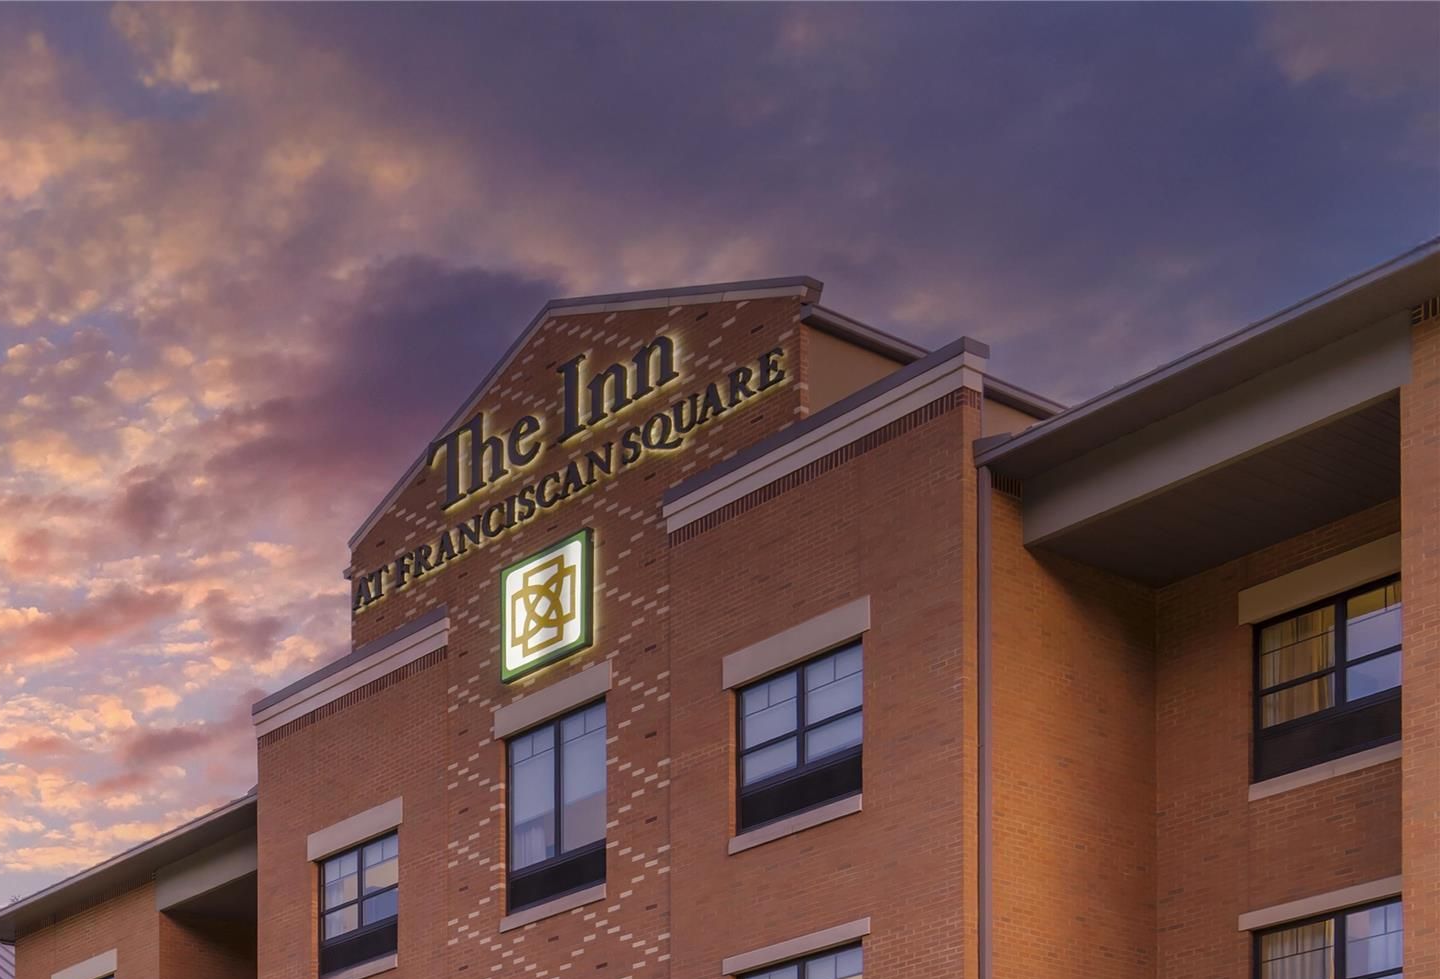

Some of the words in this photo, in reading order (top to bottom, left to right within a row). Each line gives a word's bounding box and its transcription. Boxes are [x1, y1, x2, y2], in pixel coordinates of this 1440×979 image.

[353, 564, 389, 611] AT
[395, 441, 614, 588] FRANCISCAN
[621, 347, 786, 466] SQUARE
[426, 412, 542, 511] The
[556, 335, 680, 443] Inn
